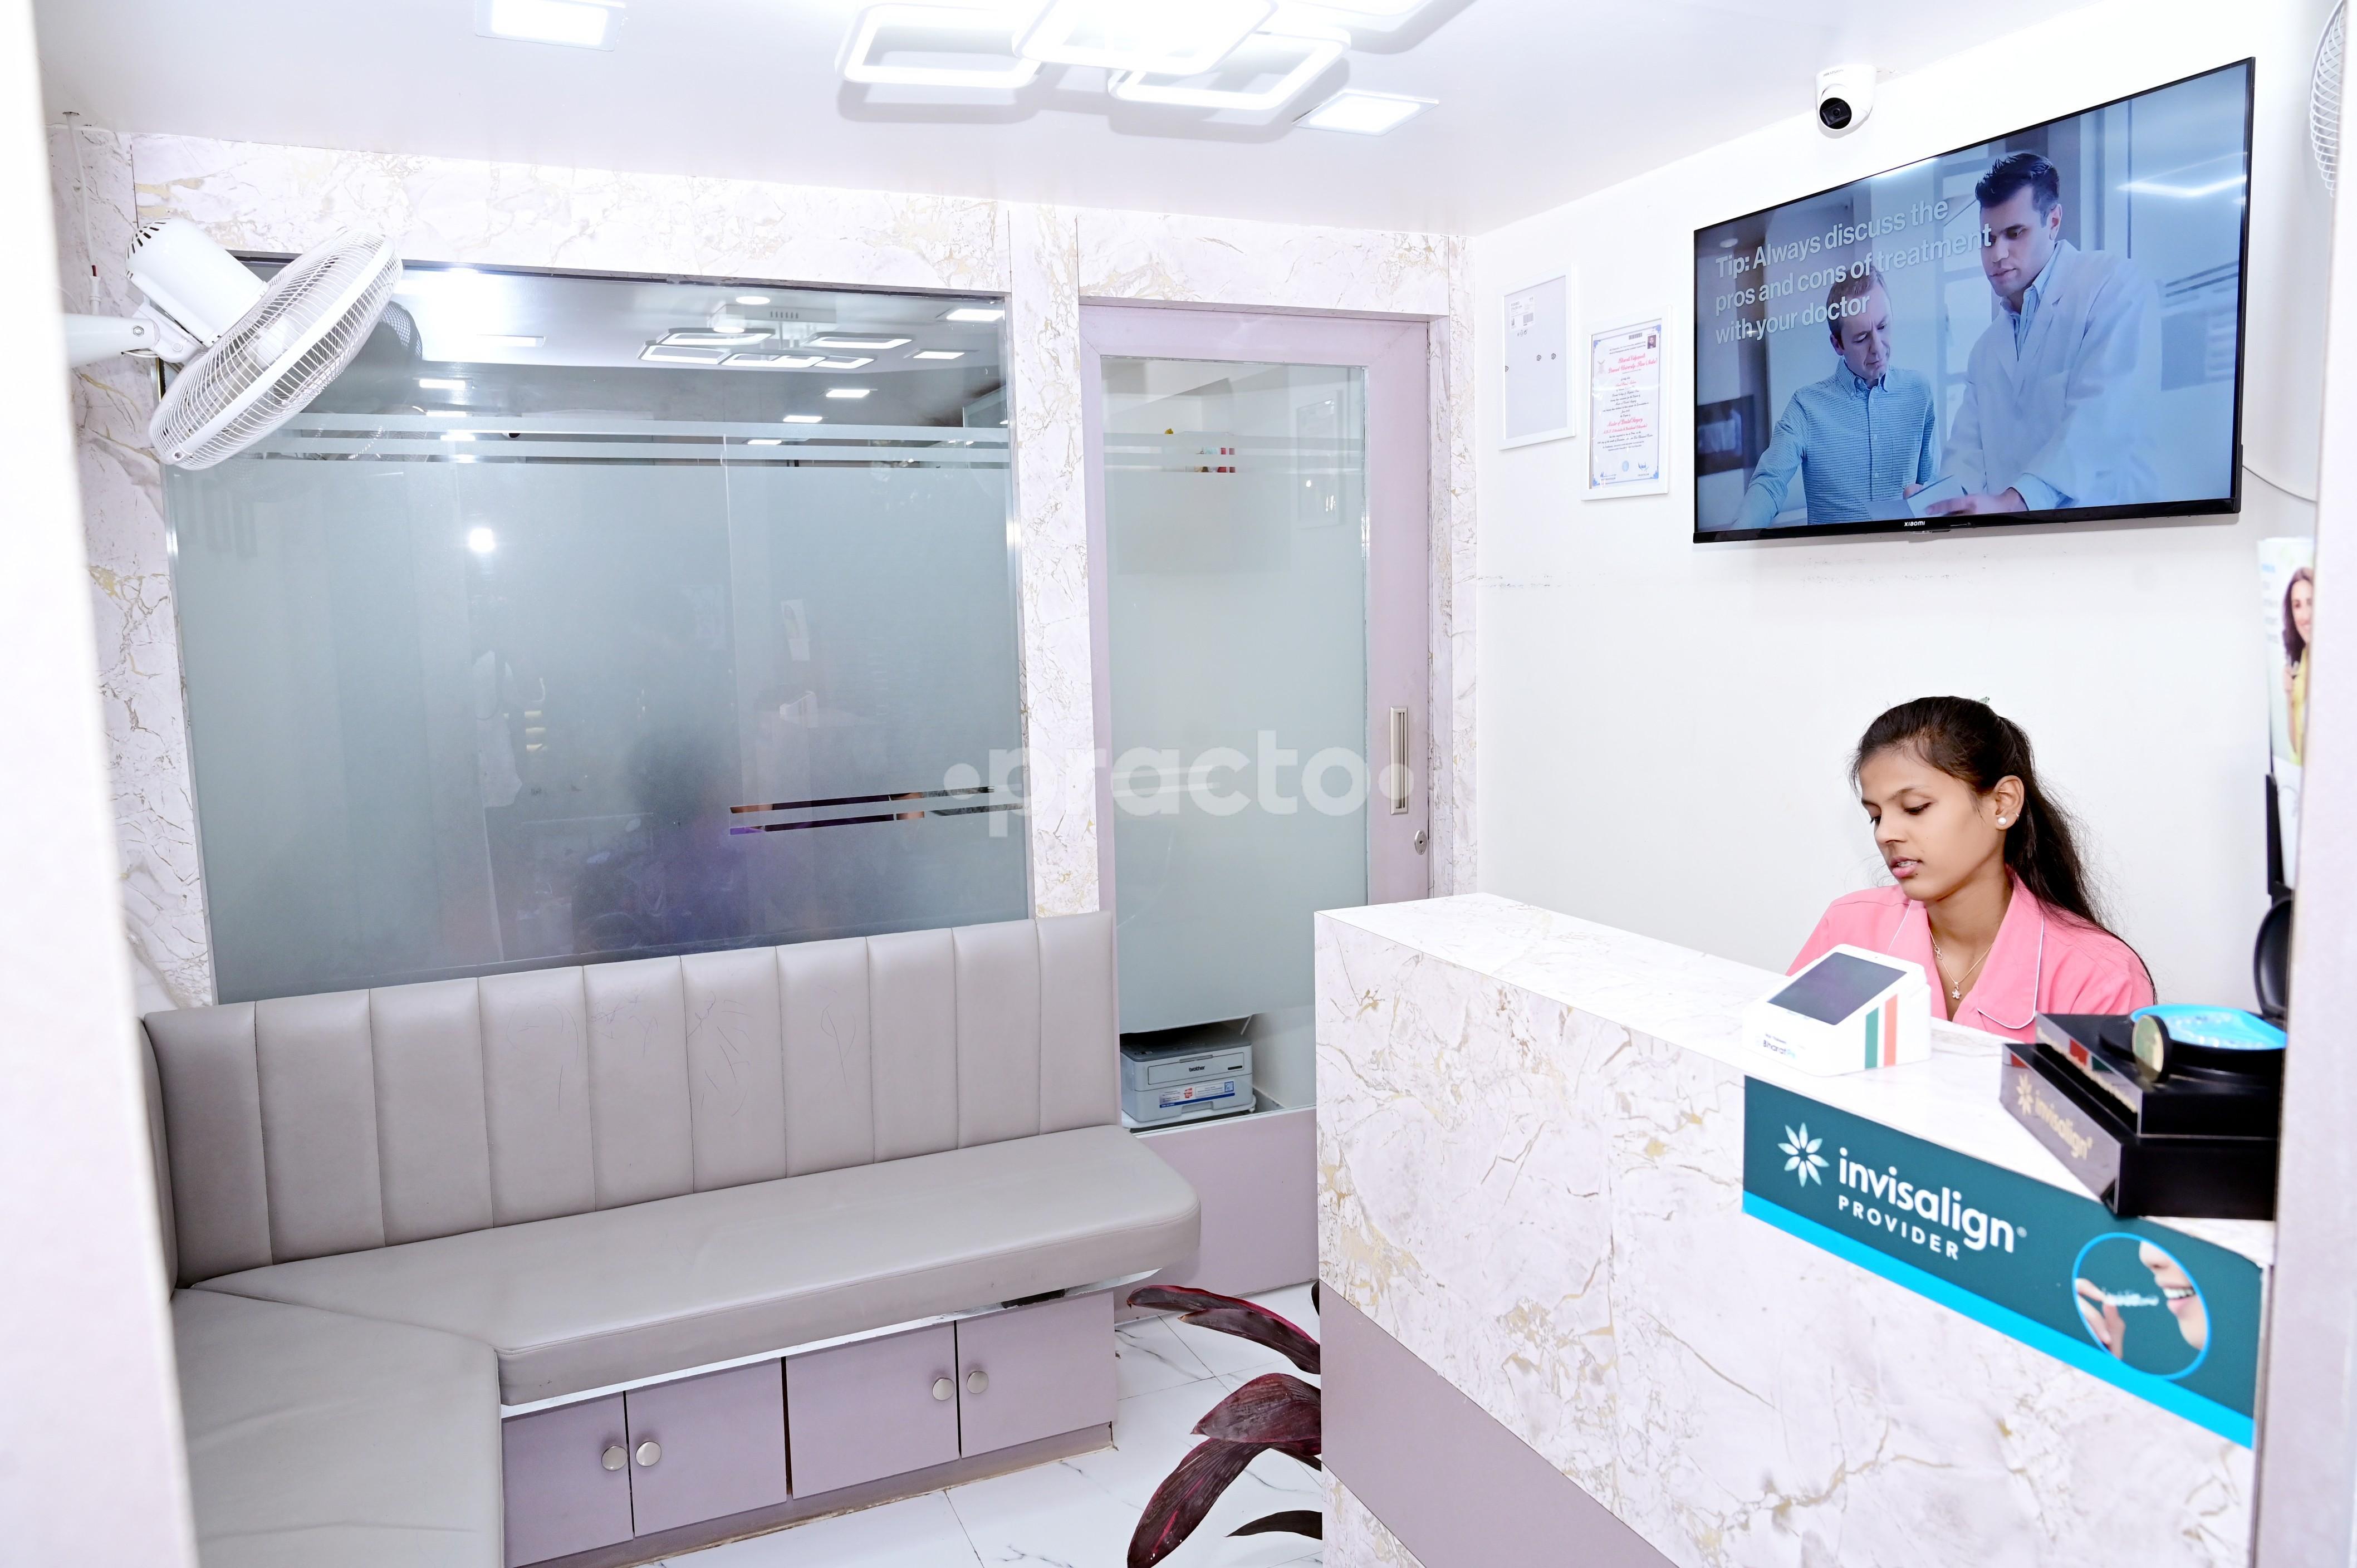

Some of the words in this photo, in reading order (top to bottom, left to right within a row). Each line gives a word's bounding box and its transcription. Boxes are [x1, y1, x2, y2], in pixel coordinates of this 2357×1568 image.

[1716, 256, 1750, 279] Tip:
[1753, 236, 1821, 270] Always
[1825, 213, 1905, 249] discuss
[1911, 201, 1948, 226] the
[1716, 288, 1756, 315] pros
[1759, 277, 1794, 301] and
[1797, 264, 1846, 292] cons
[1850, 253, 1874, 279] of
[1876, 223, 1992, 273] treatment
[1716, 318, 1752, 344] with
[1756, 312, 1799, 339] your
[1802, 296, 1870, 326] doctor
[1839, 1195, 1959, 1261] PROVIDER
